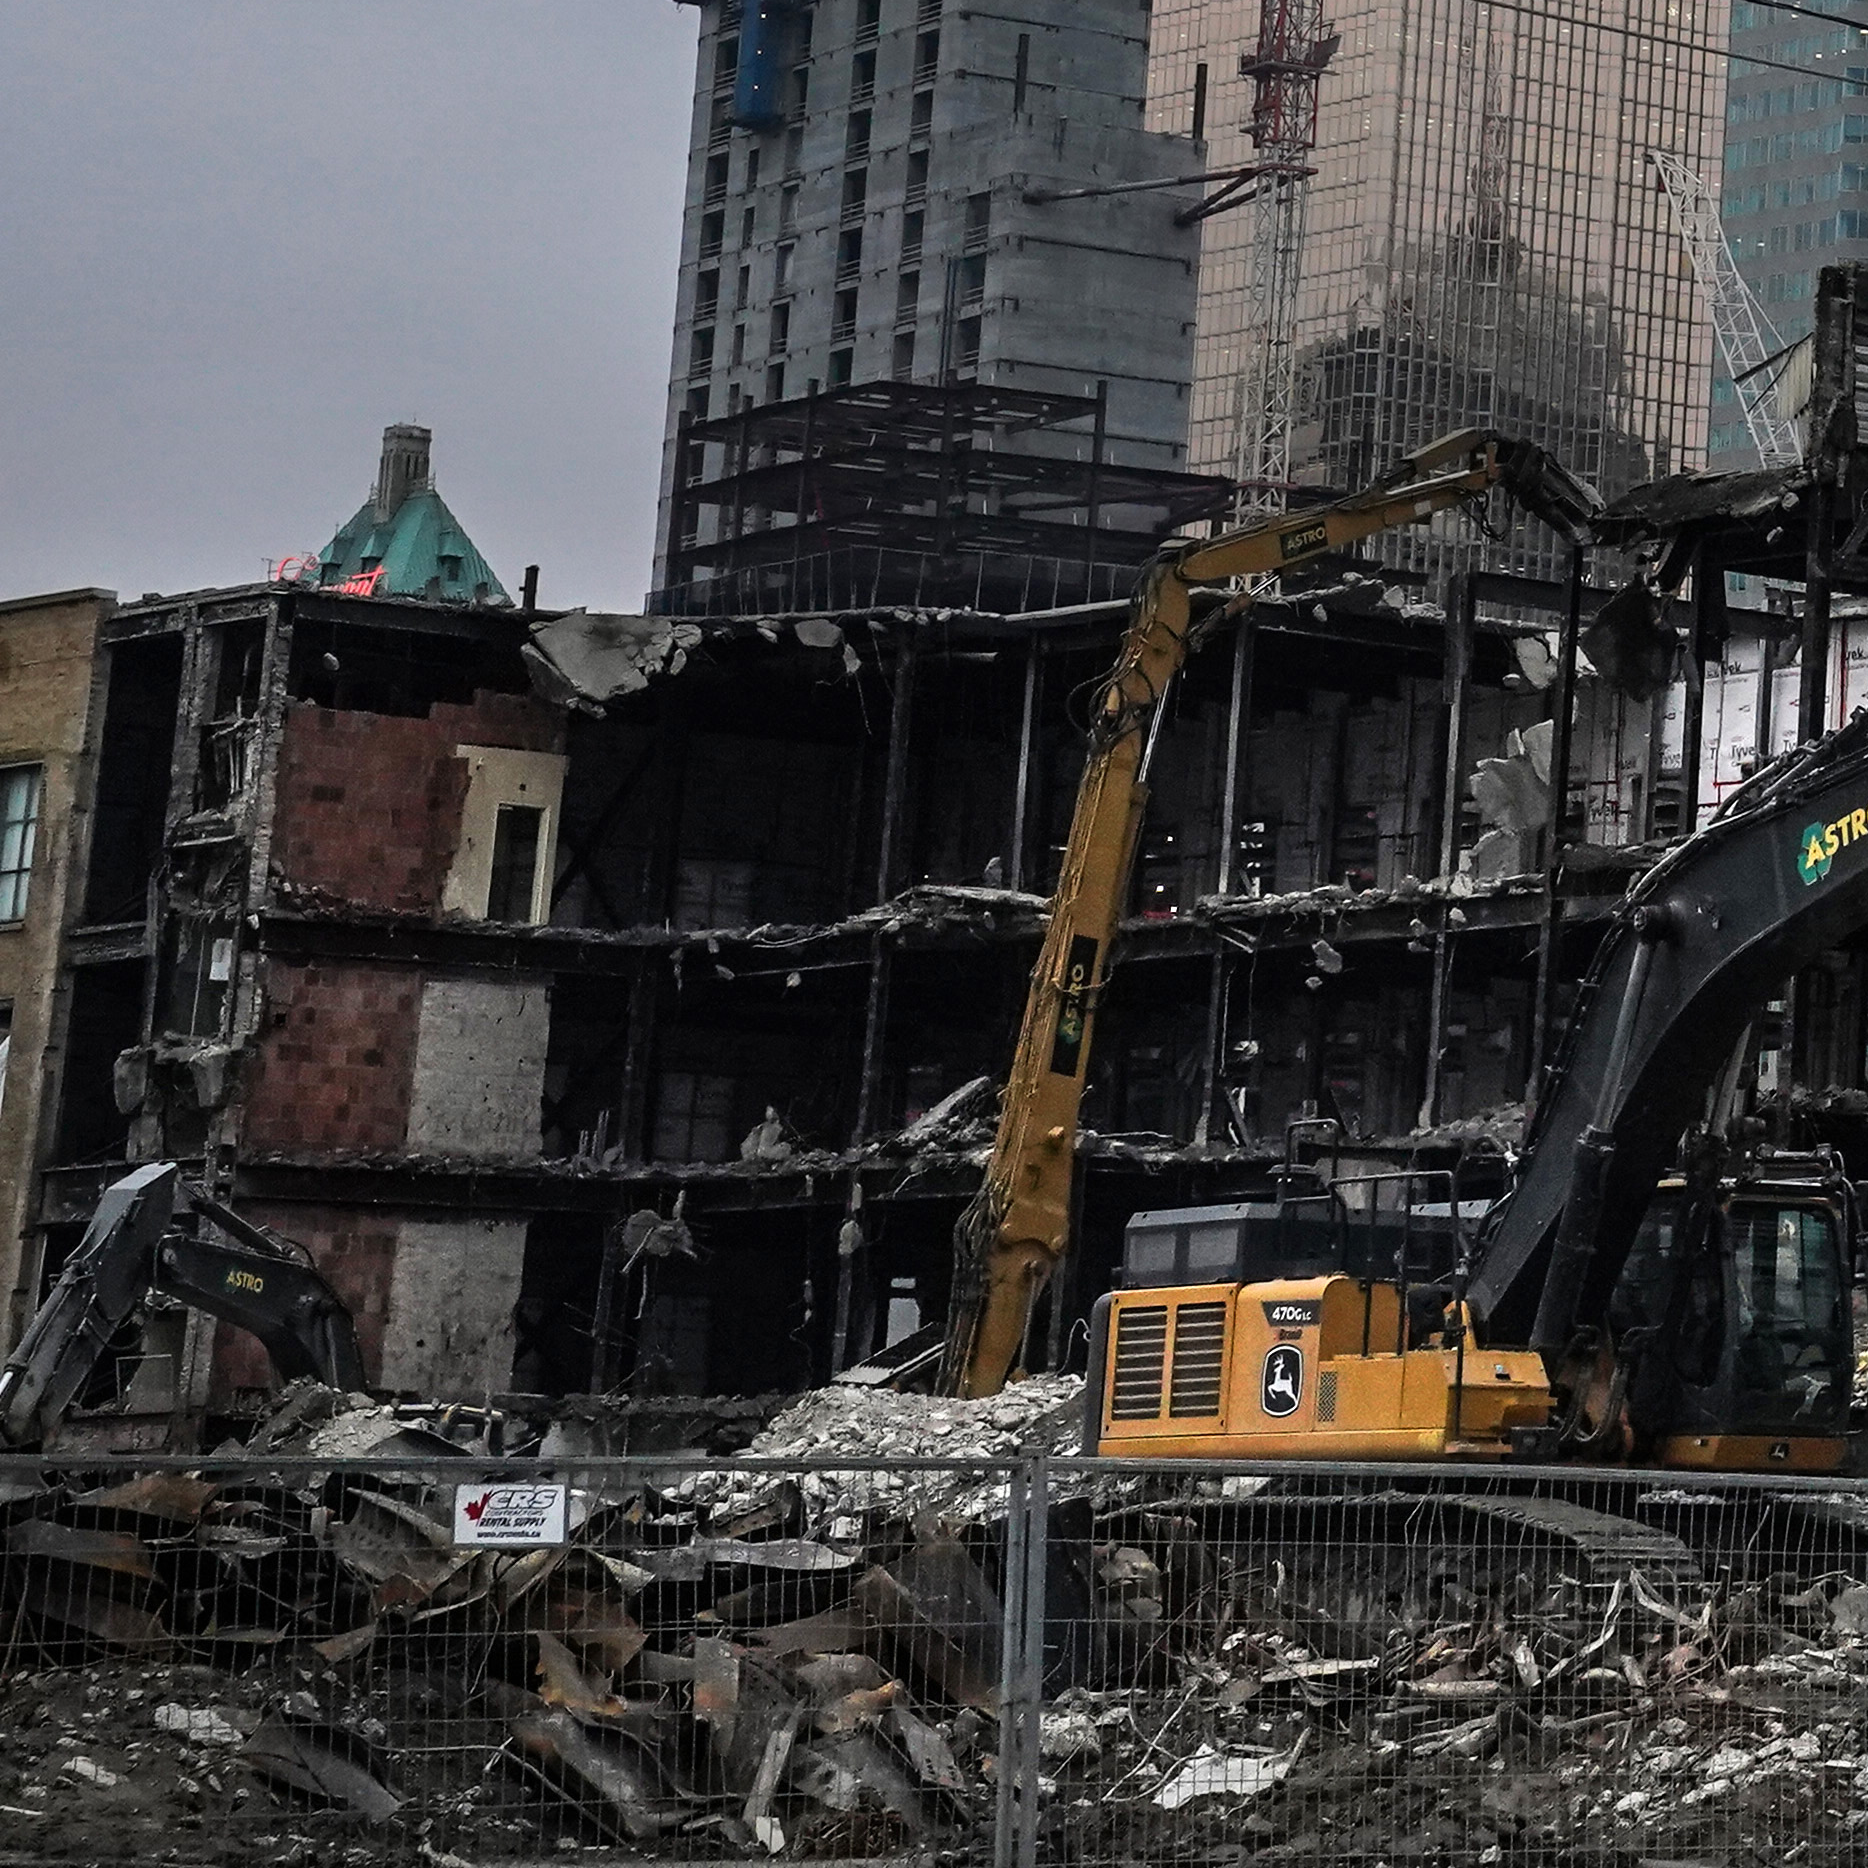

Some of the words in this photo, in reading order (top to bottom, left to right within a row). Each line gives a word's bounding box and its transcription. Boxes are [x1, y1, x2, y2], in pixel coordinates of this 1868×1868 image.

[1287, 527, 1326, 550] ASTRO
[1731, 743, 1757, 758] Tyve
[226, 1270, 264, 1293] ASTRO
[488, 1488, 558, 1510] CRS
[480, 1517, 511, 1527] RENTAL
[513, 1517, 547, 1527] SUPPLY
